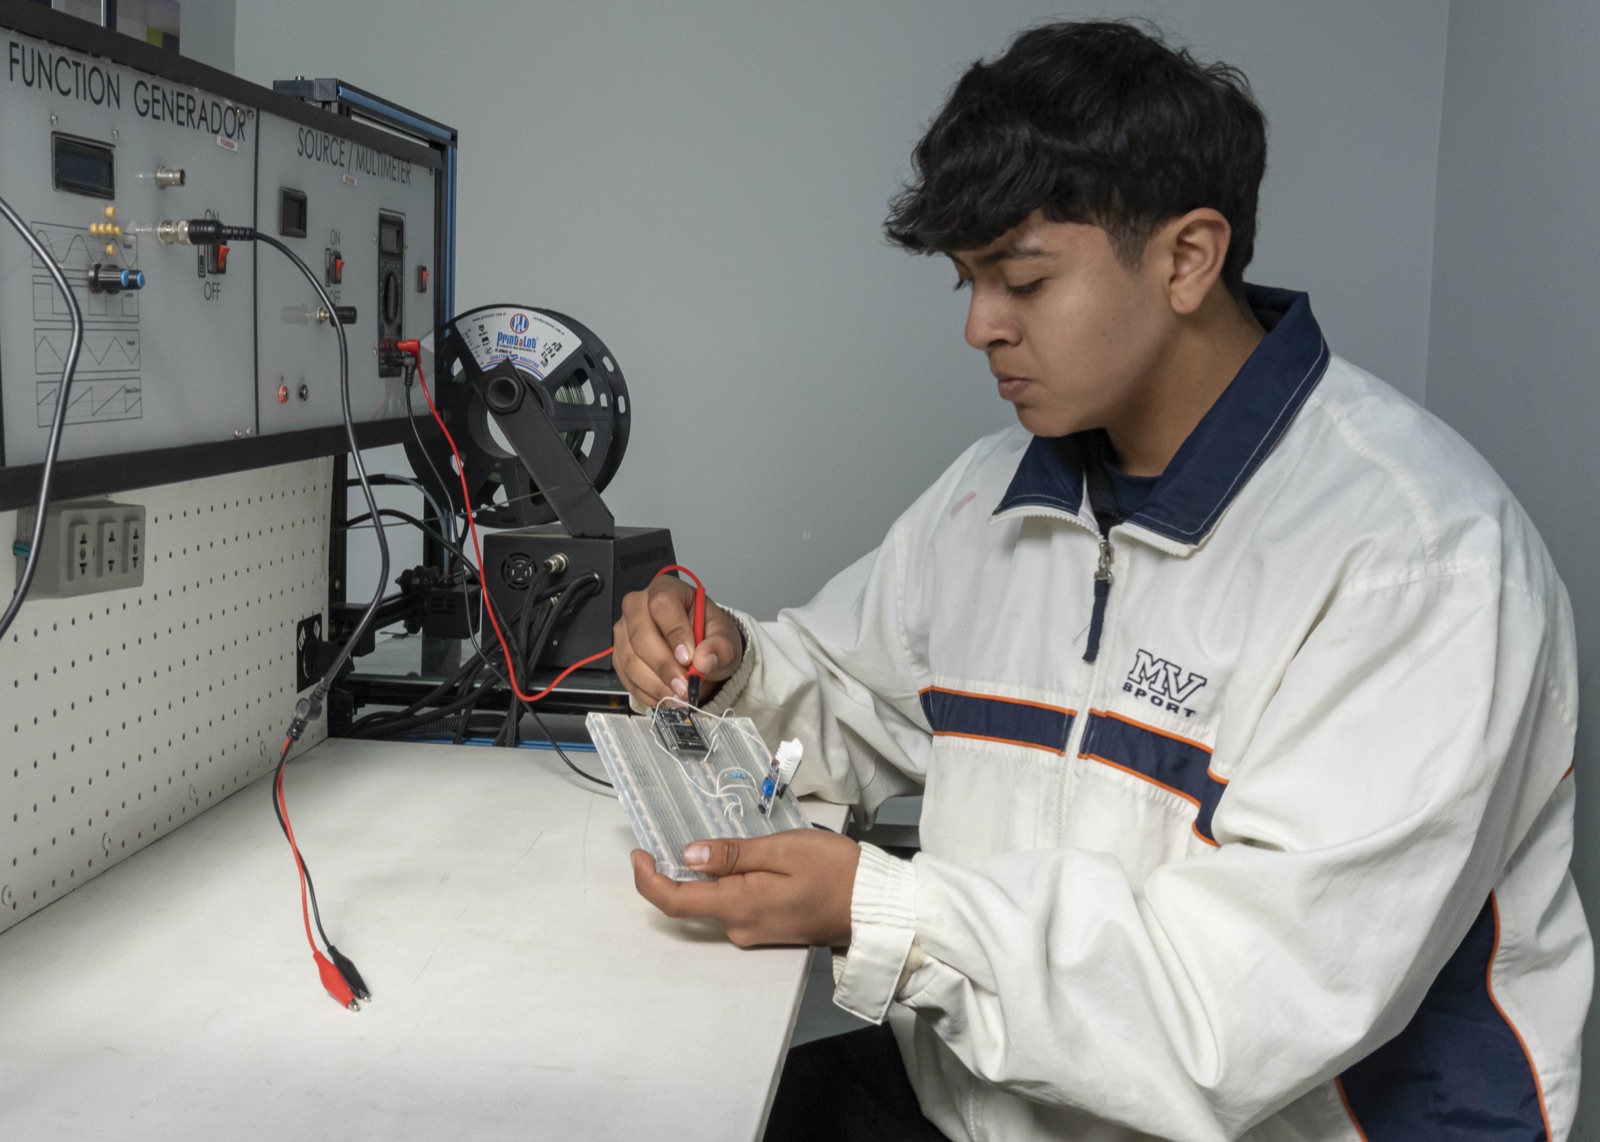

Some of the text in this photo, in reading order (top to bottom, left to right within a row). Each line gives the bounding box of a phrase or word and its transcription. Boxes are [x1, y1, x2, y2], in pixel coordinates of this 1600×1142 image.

[9, 40, 247, 142] FUNCTION GENERADOR
[297, 126, 346, 168] SOURCE
[356, 146, 411, 186] MULTIMETER
[330, 228, 340, 246] ON
[203, 281, 221, 301] OFF
[298, 626, 306, 652] OFF
[1127, 648, 1208, 704] MV
[1122, 681, 1196, 718] SPORT
